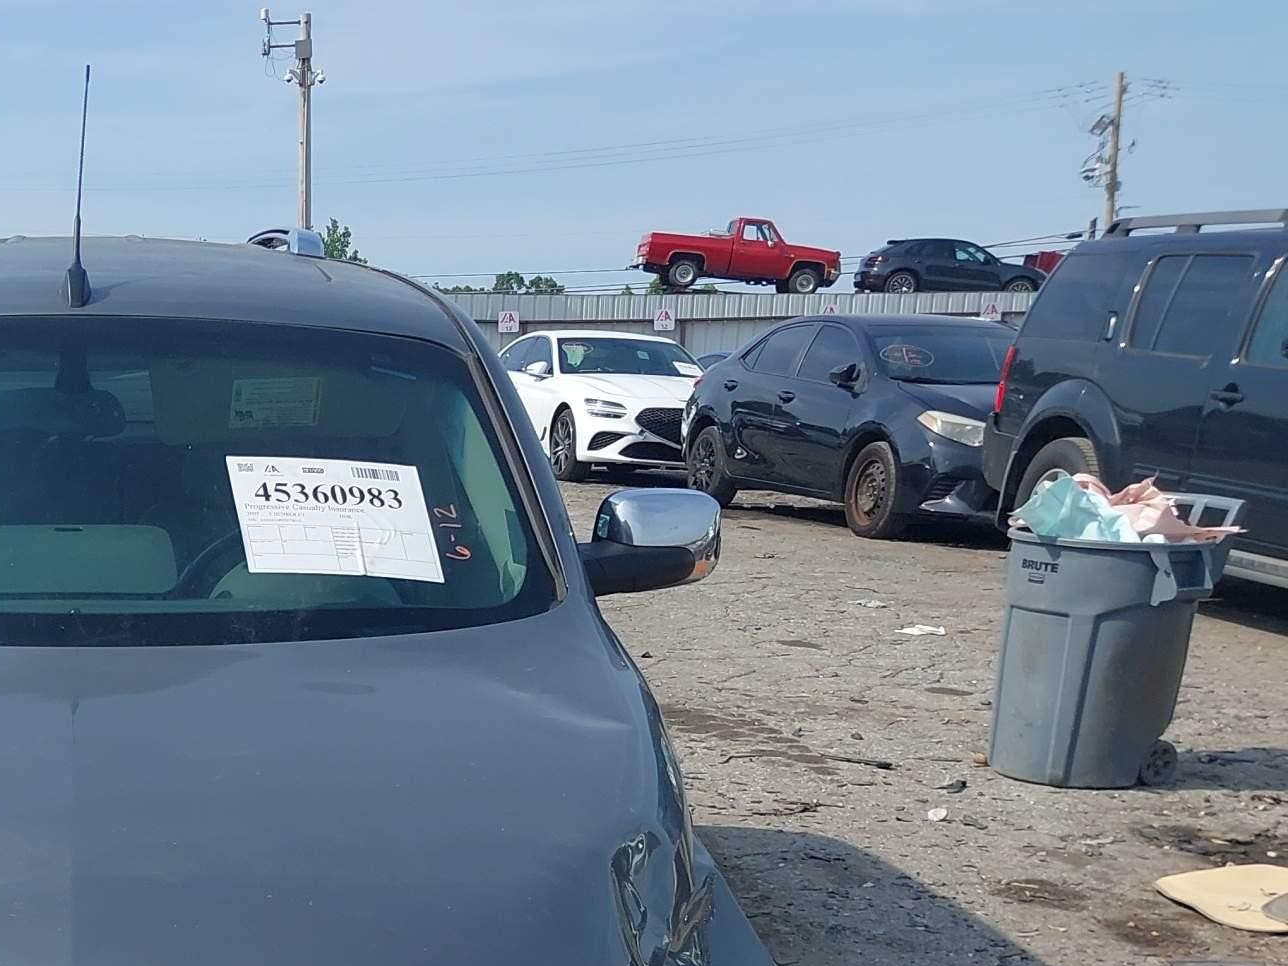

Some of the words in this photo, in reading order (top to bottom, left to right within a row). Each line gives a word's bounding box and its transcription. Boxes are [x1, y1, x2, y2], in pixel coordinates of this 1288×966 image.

[254, 481, 403, 509] 45360983
[244, 503, 290, 511] Progressive
[292, 504, 326, 513] Casualty
[328, 505, 365, 513] Insurance
[433, 504, 472, 560] 6-12
[1022, 559, 1059, 573] BRUTE
